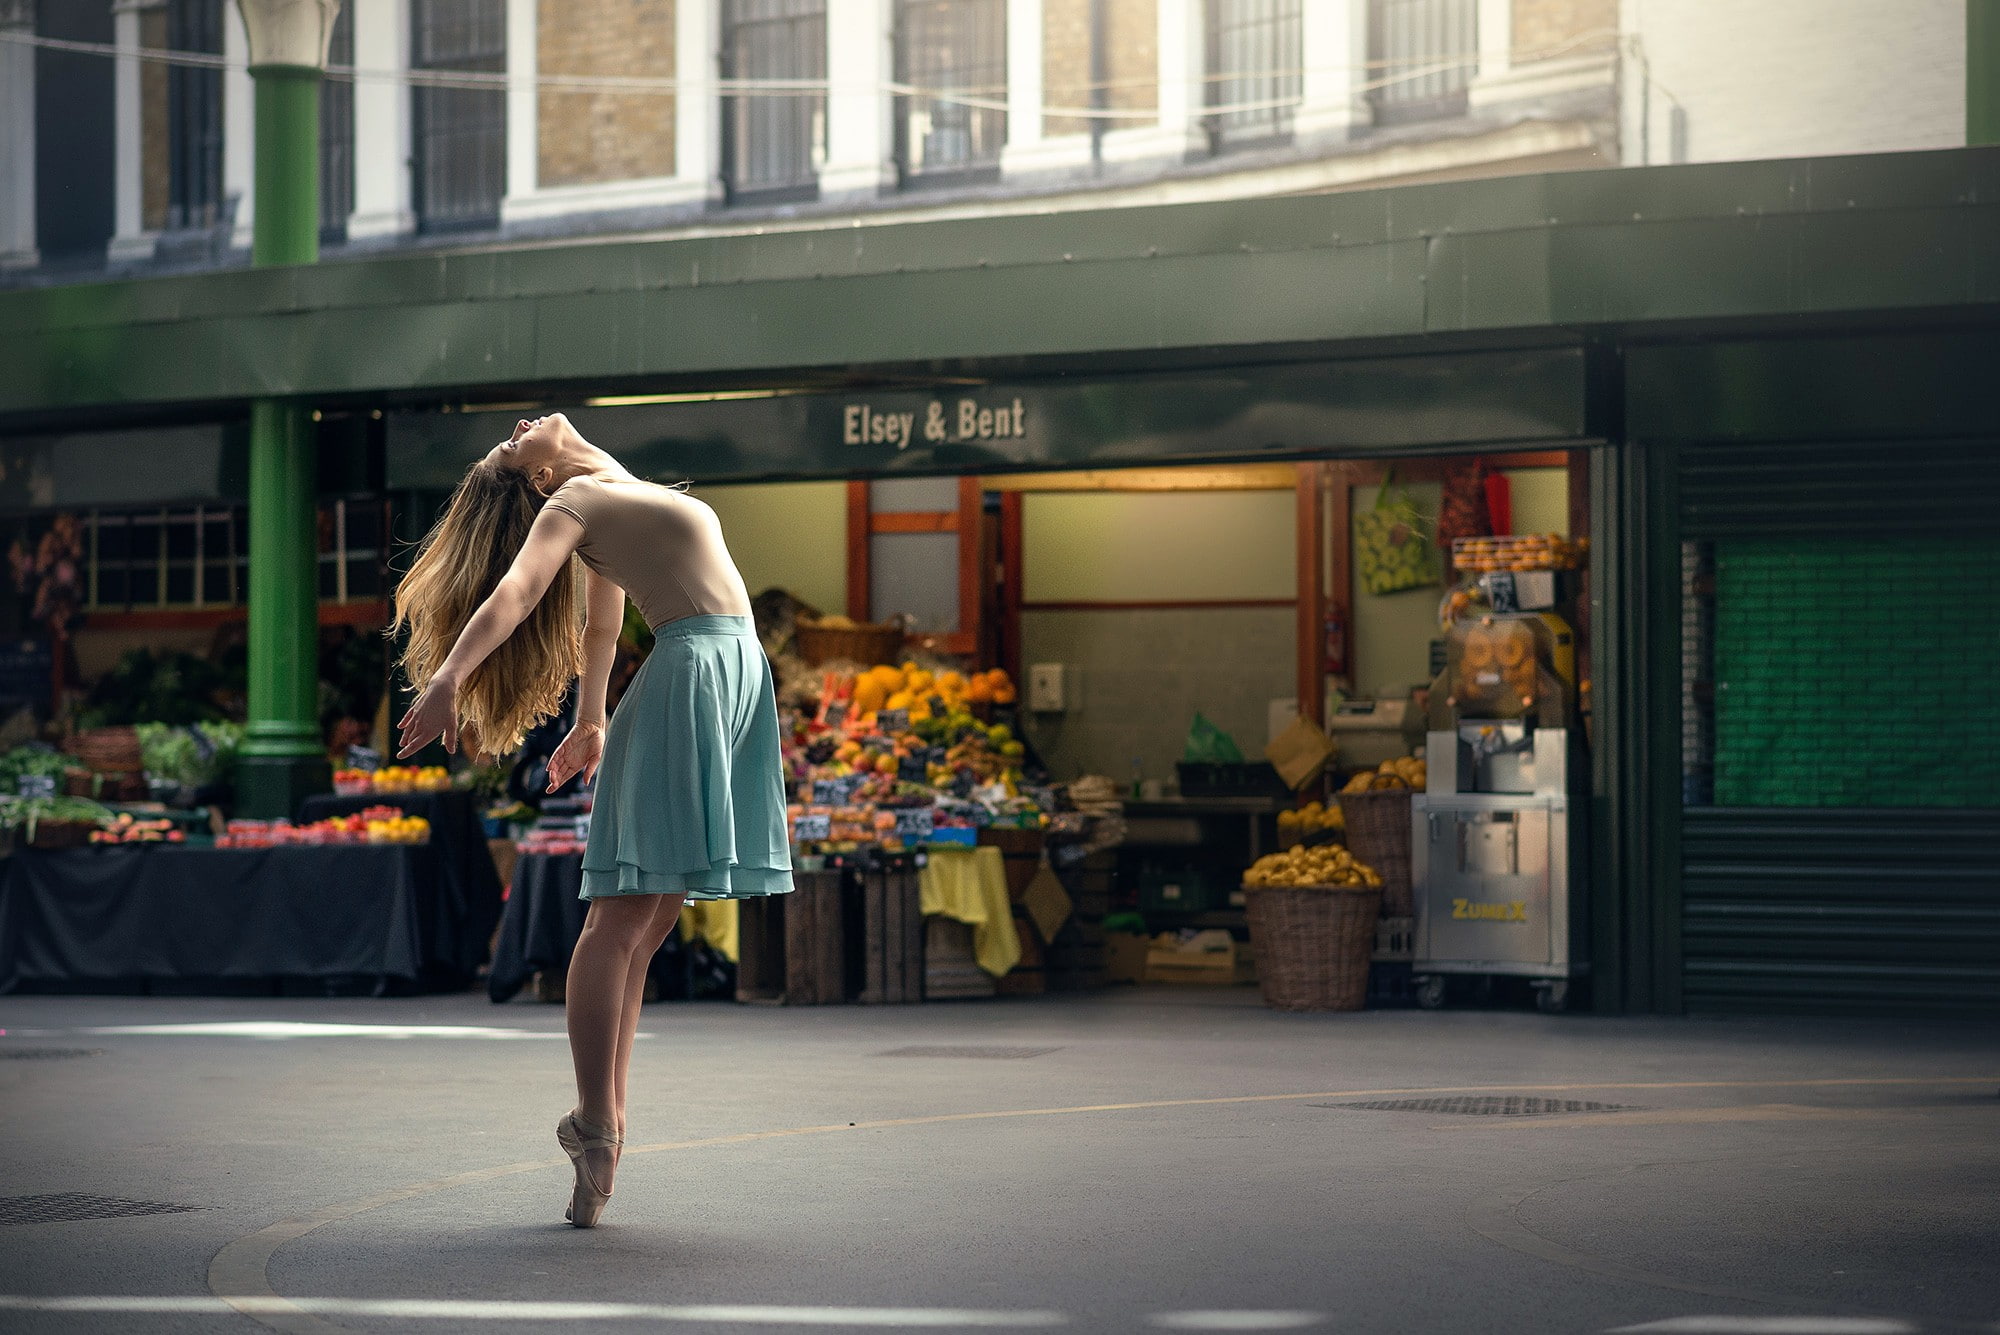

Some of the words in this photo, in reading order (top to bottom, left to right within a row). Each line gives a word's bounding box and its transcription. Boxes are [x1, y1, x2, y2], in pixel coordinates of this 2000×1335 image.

[843, 403, 914, 450] Elsey
[924, 400, 947, 441] &
[957, 398, 1025, 440] Bent
